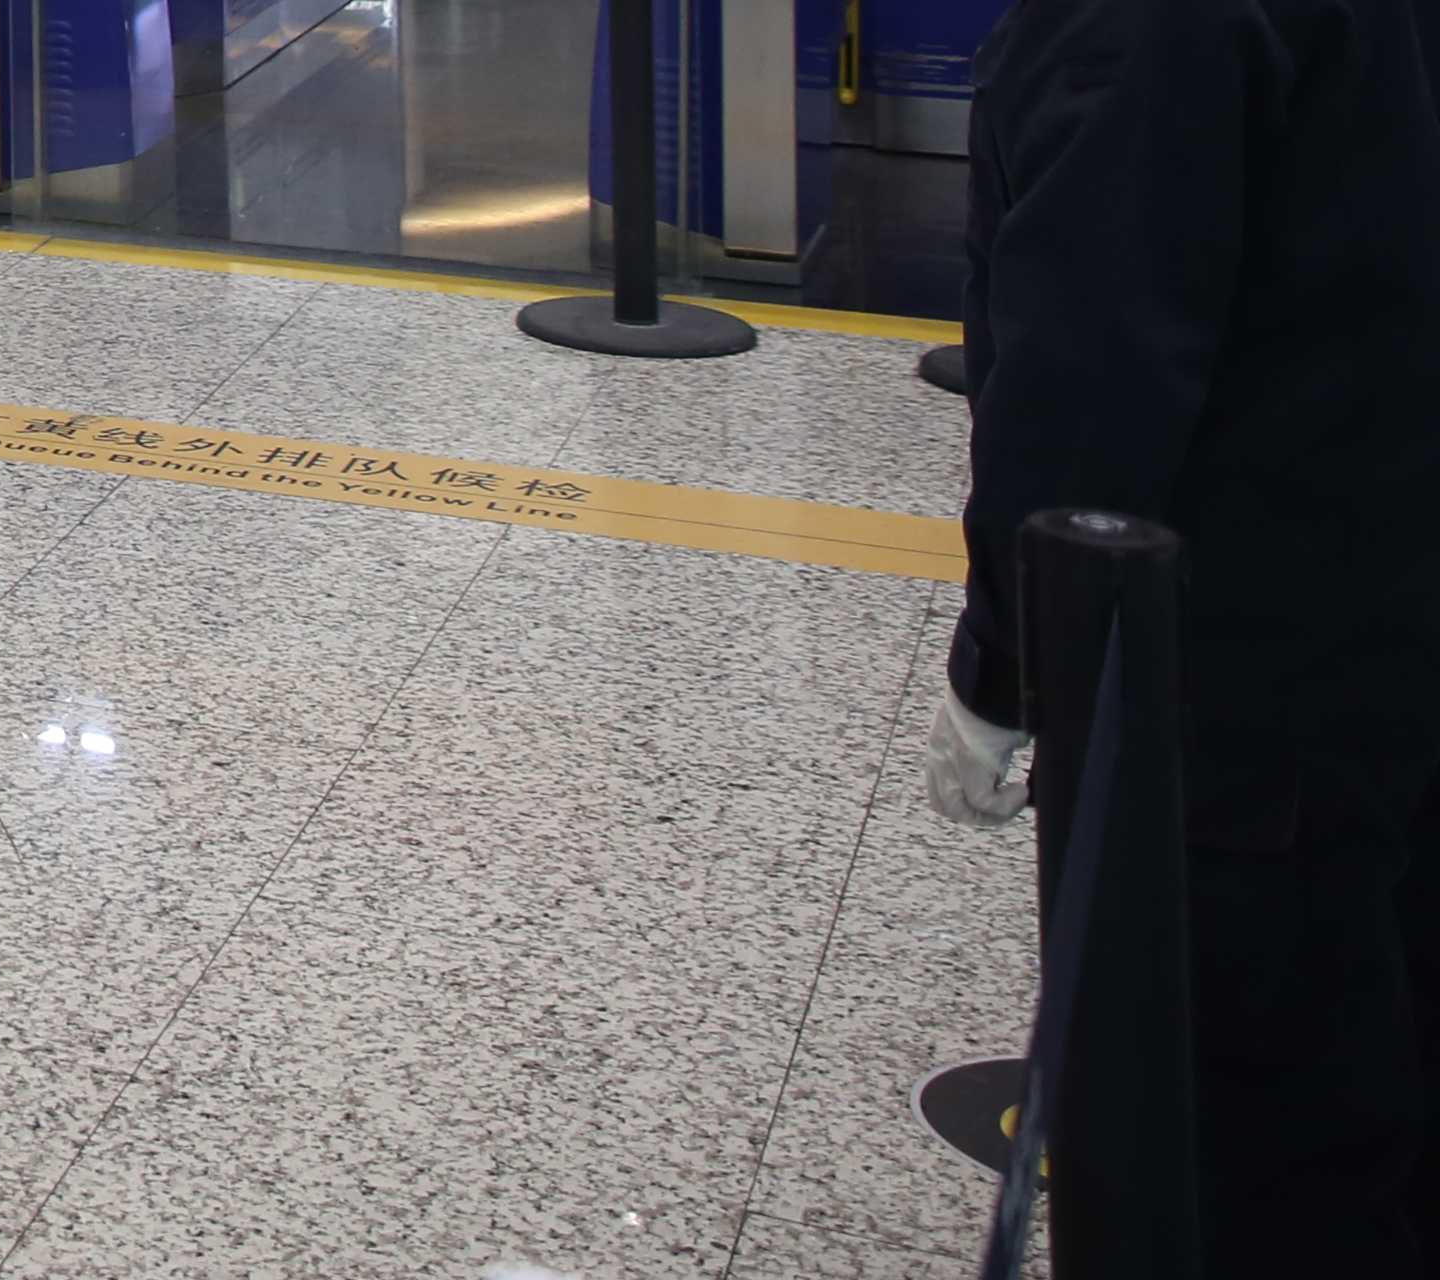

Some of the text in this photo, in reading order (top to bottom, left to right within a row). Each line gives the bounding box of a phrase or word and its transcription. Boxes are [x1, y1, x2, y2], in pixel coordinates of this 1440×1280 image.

[107, 452, 250, 480] Behind
[261, 472, 323, 488] the
[338, 481, 474, 507] Yellow
[485, 500, 578, 522] Line
